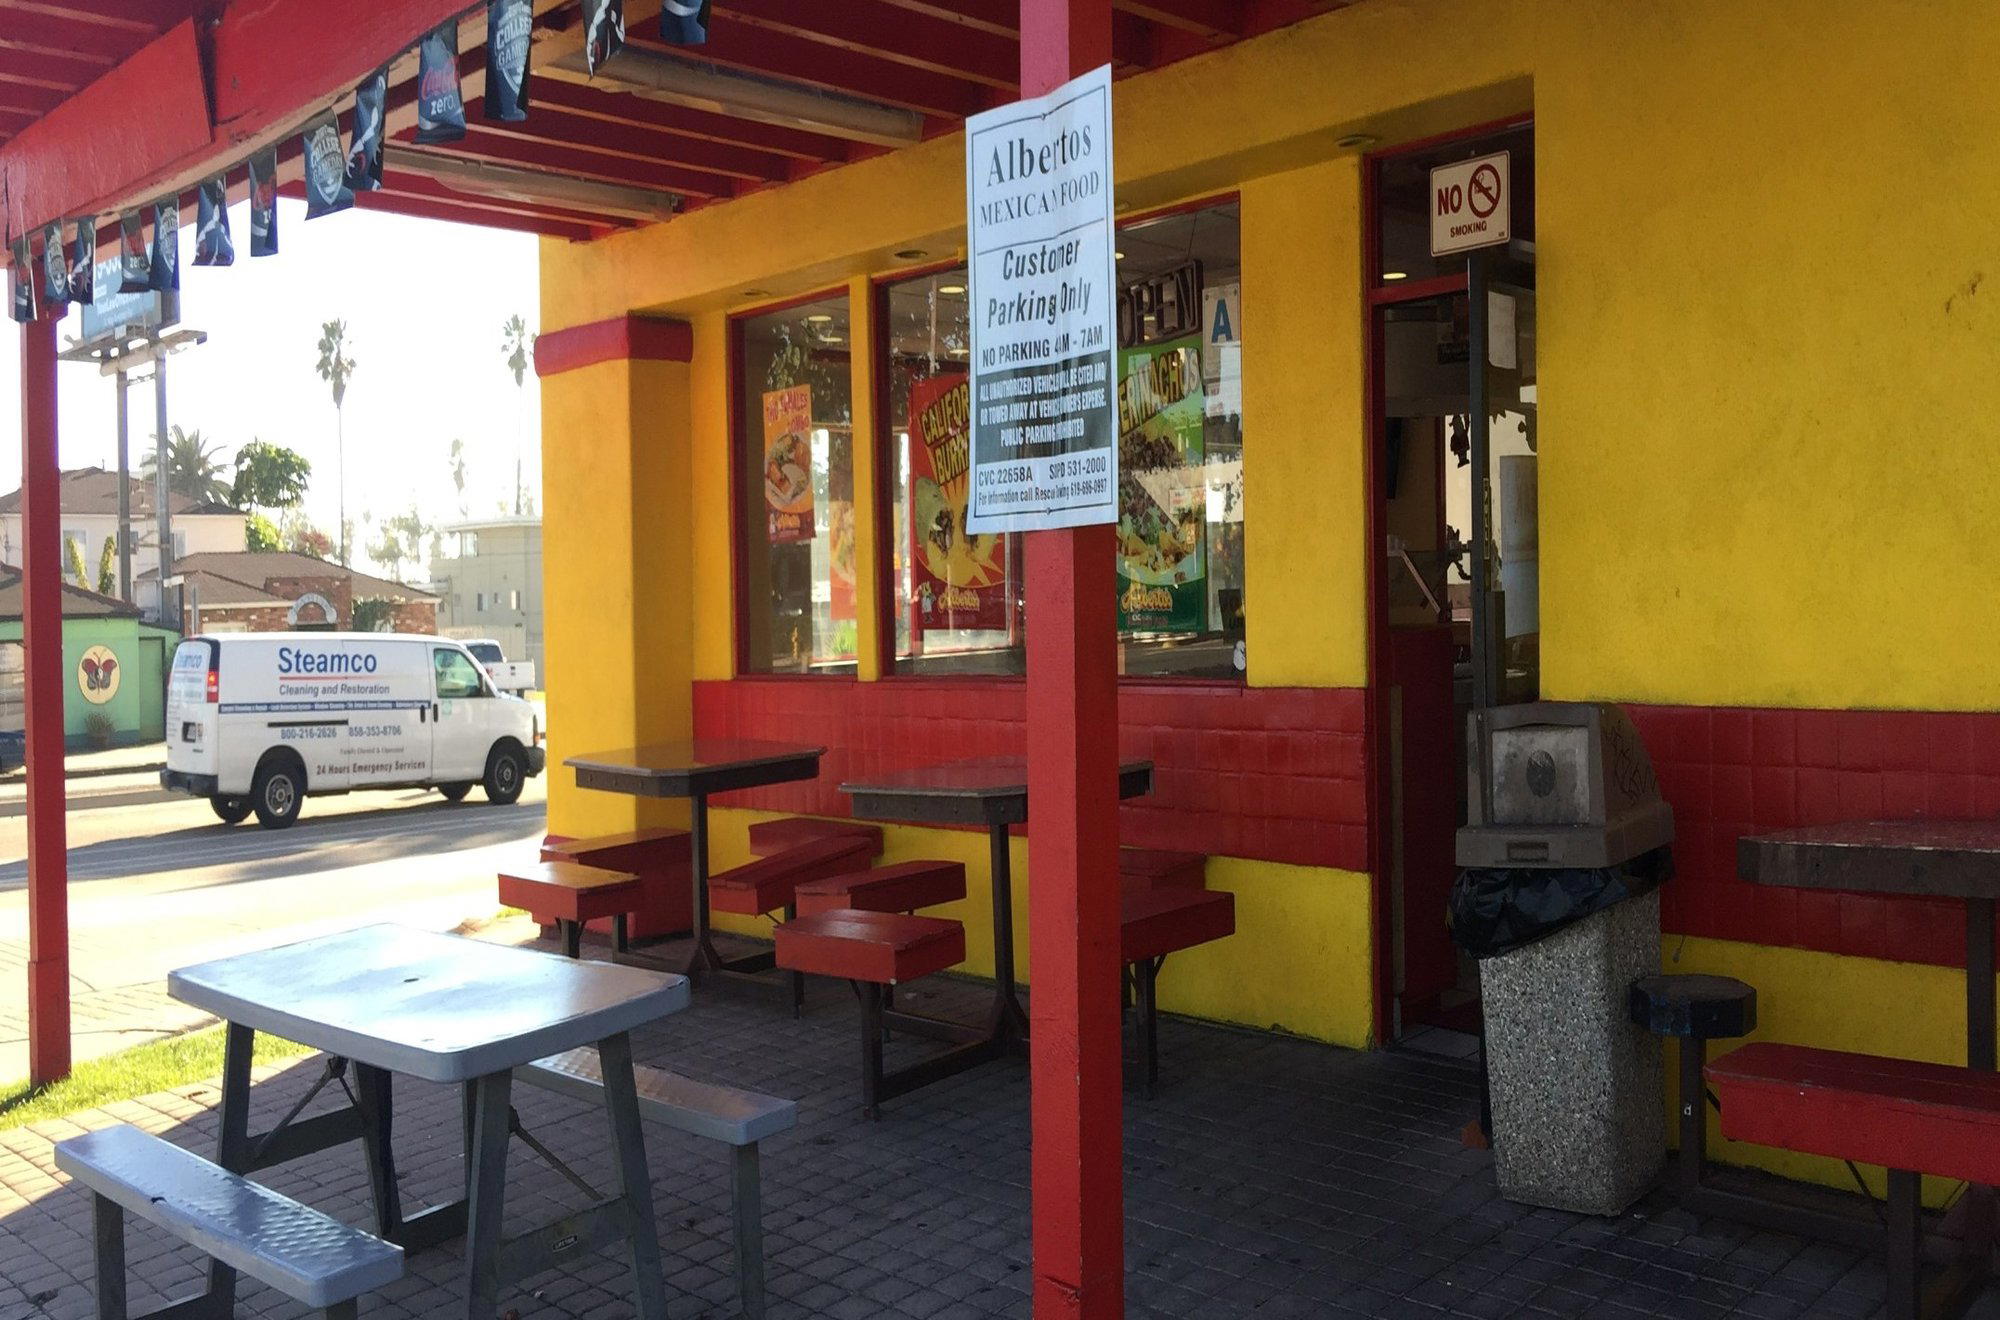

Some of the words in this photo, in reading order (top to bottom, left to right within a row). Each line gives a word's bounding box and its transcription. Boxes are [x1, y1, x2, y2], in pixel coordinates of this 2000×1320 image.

[987, 124, 1092, 188] Albertos
[1060, 170, 1100, 207] FOOD
[1437, 184, 1463, 216] NO
[1449, 220, 1488, 238] SMOKING
[988, 288, 1057, 329] Parking
[1060, 277, 1092, 316] Only
[1211, 298, 1233, 345] A
[982, 348, 996, 368] NO
[999, 339, 1050, 364] PARKING
[1080, 325, 1104, 349] 7AM
[1009, 401, 1028, 421] AWAY
[1029, 399, 1038, 419] AT
[1025, 422, 1056, 445] PARKING
[978, 471, 995, 487] CVC
[997, 465, 1033, 484] 22658A
[1067, 455, 1107, 477] 531-2000
[1020, 485, 1032, 502] call
[278, 646, 378, 675] Steamco
[279, 683, 319, 698] Cleaning
[321, 683, 338, 695] and
[340, 683, 391, 695] Restoration
[316, 764, 327, 775] 24
[328, 763, 349, 774] Hours
[352, 761, 393, 775] Emergency
[395, 760, 426, 770] Services
